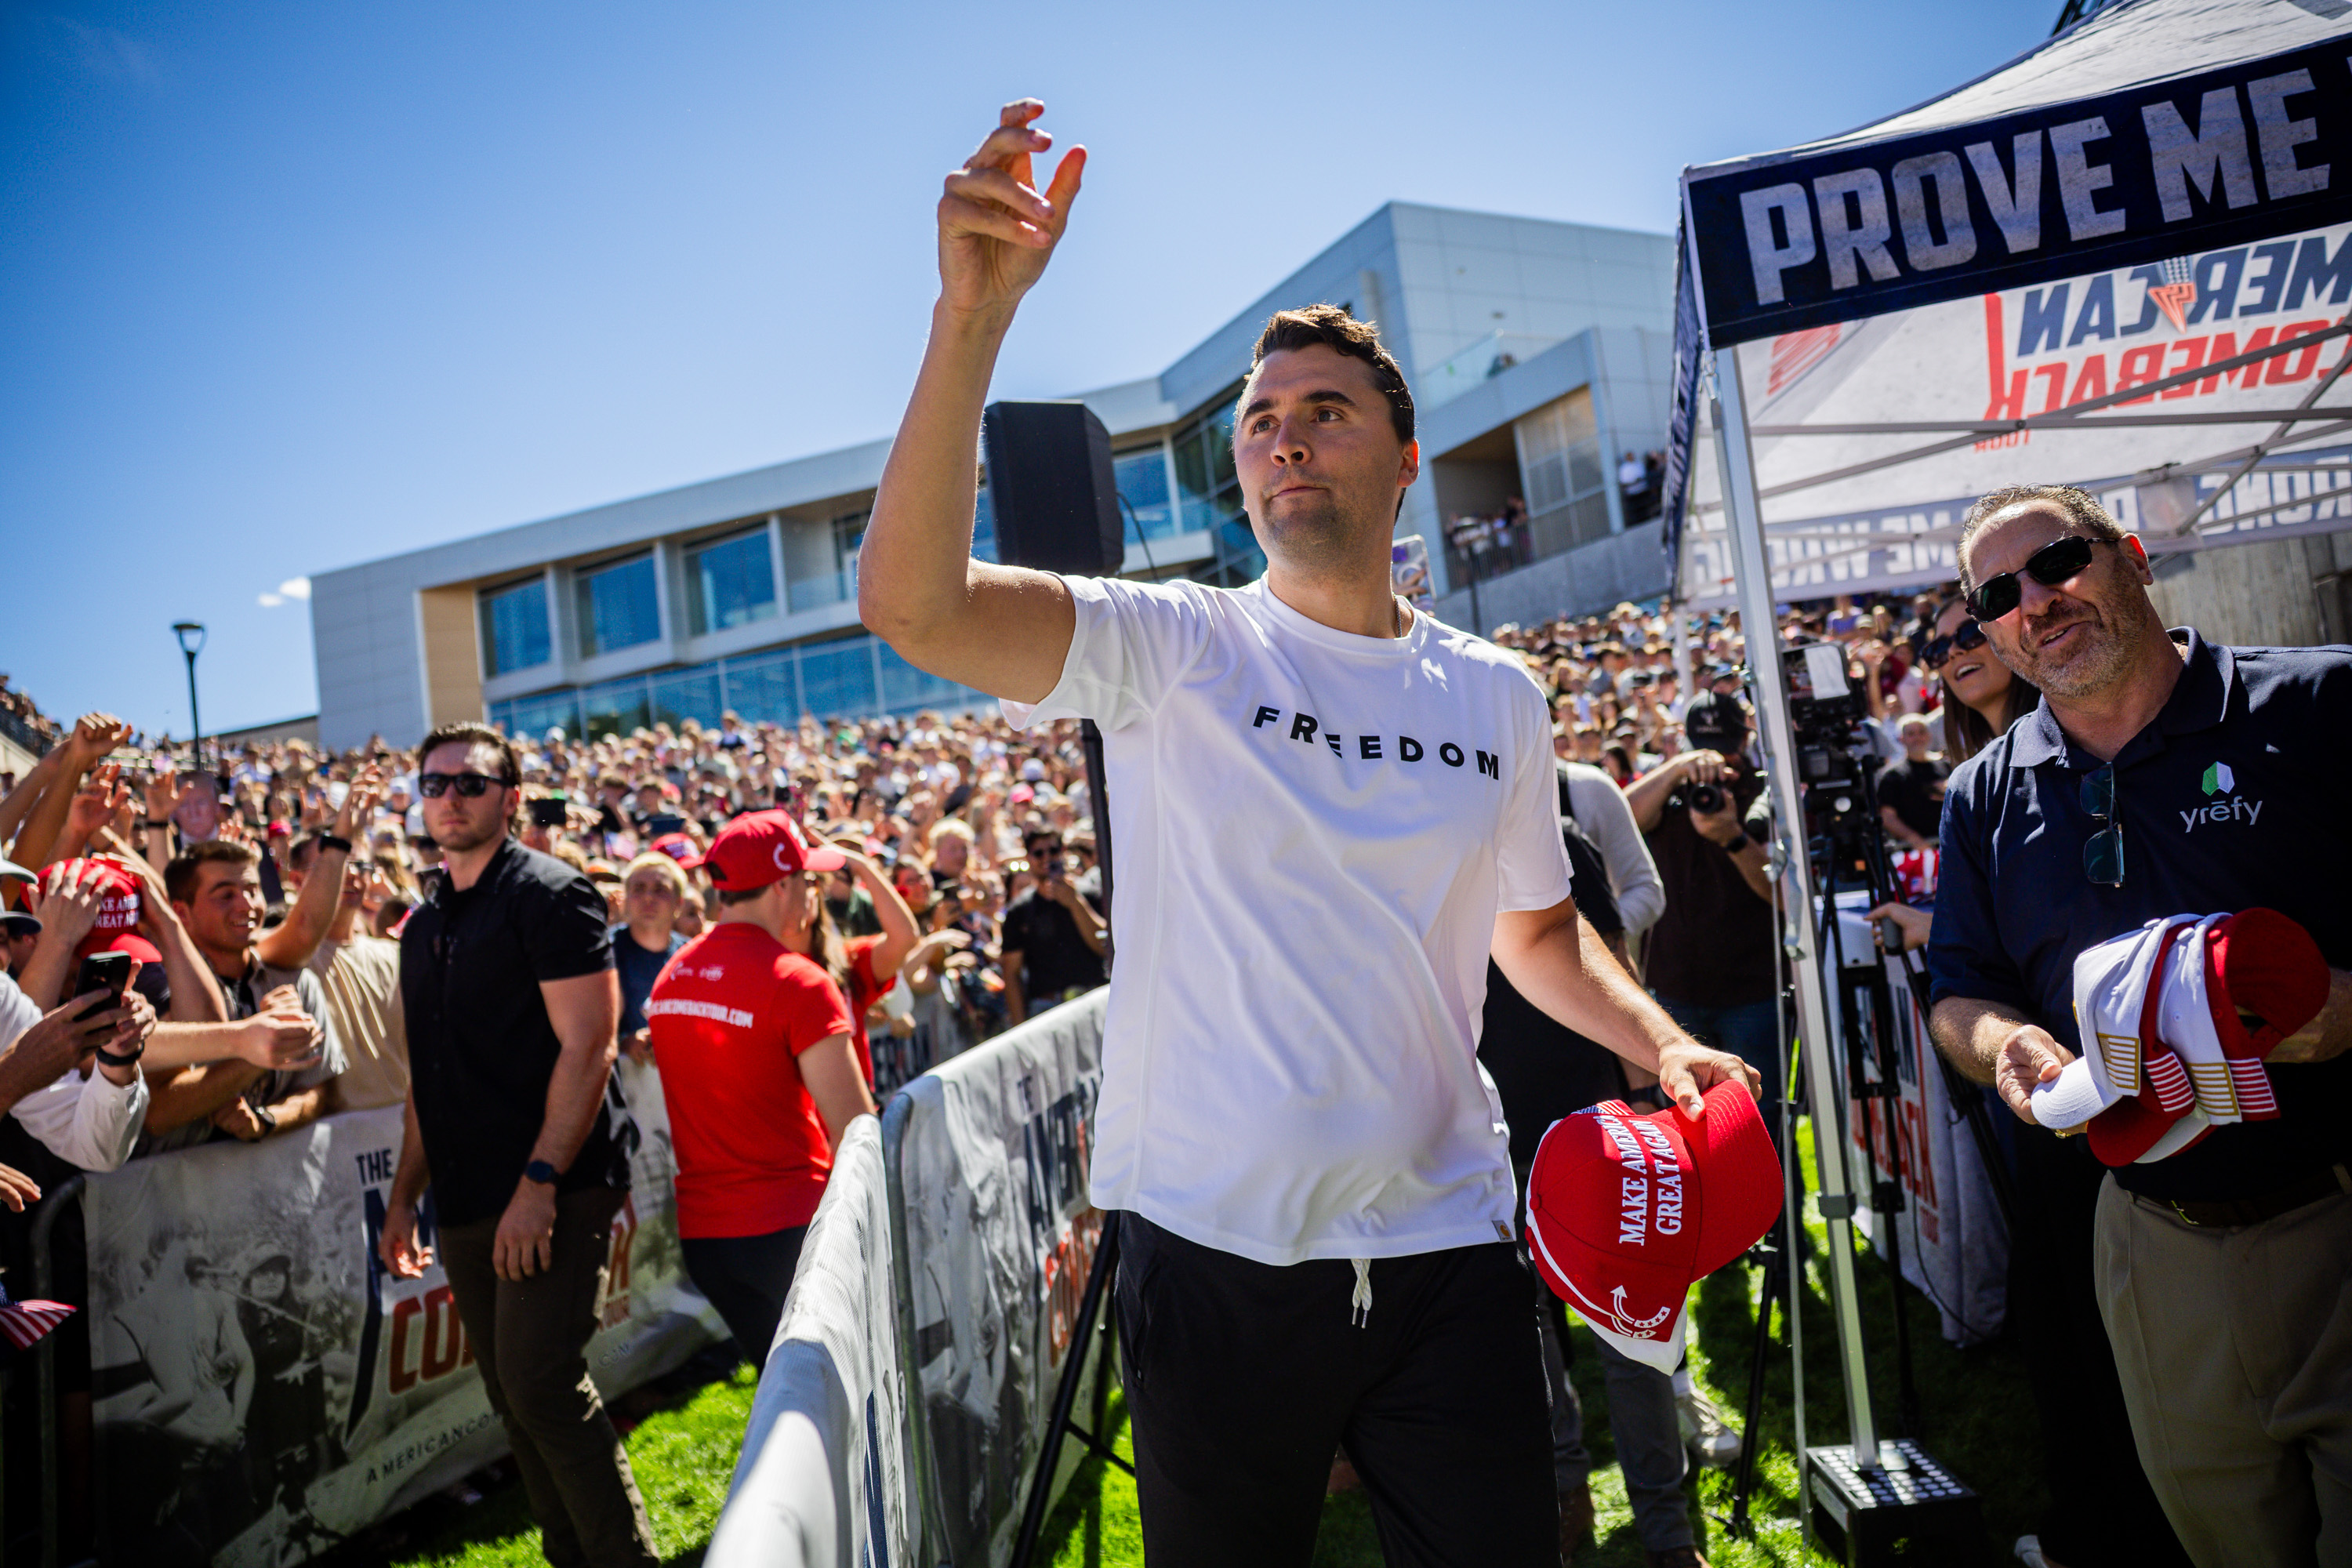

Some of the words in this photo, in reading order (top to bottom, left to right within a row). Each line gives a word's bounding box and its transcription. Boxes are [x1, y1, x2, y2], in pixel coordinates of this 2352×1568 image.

[1739, 115, 2126, 307] PROVE
[2141, 67, 2331, 223] ME
[1253, 706, 1499, 781] FREEDOM
[355, 1147, 394, 1186] THE
[1628, 1119, 1677, 1160] AGAIN
[1619, 1177, 1648, 1247] MAKE
[1654, 1159, 1682, 1236] GREAT
